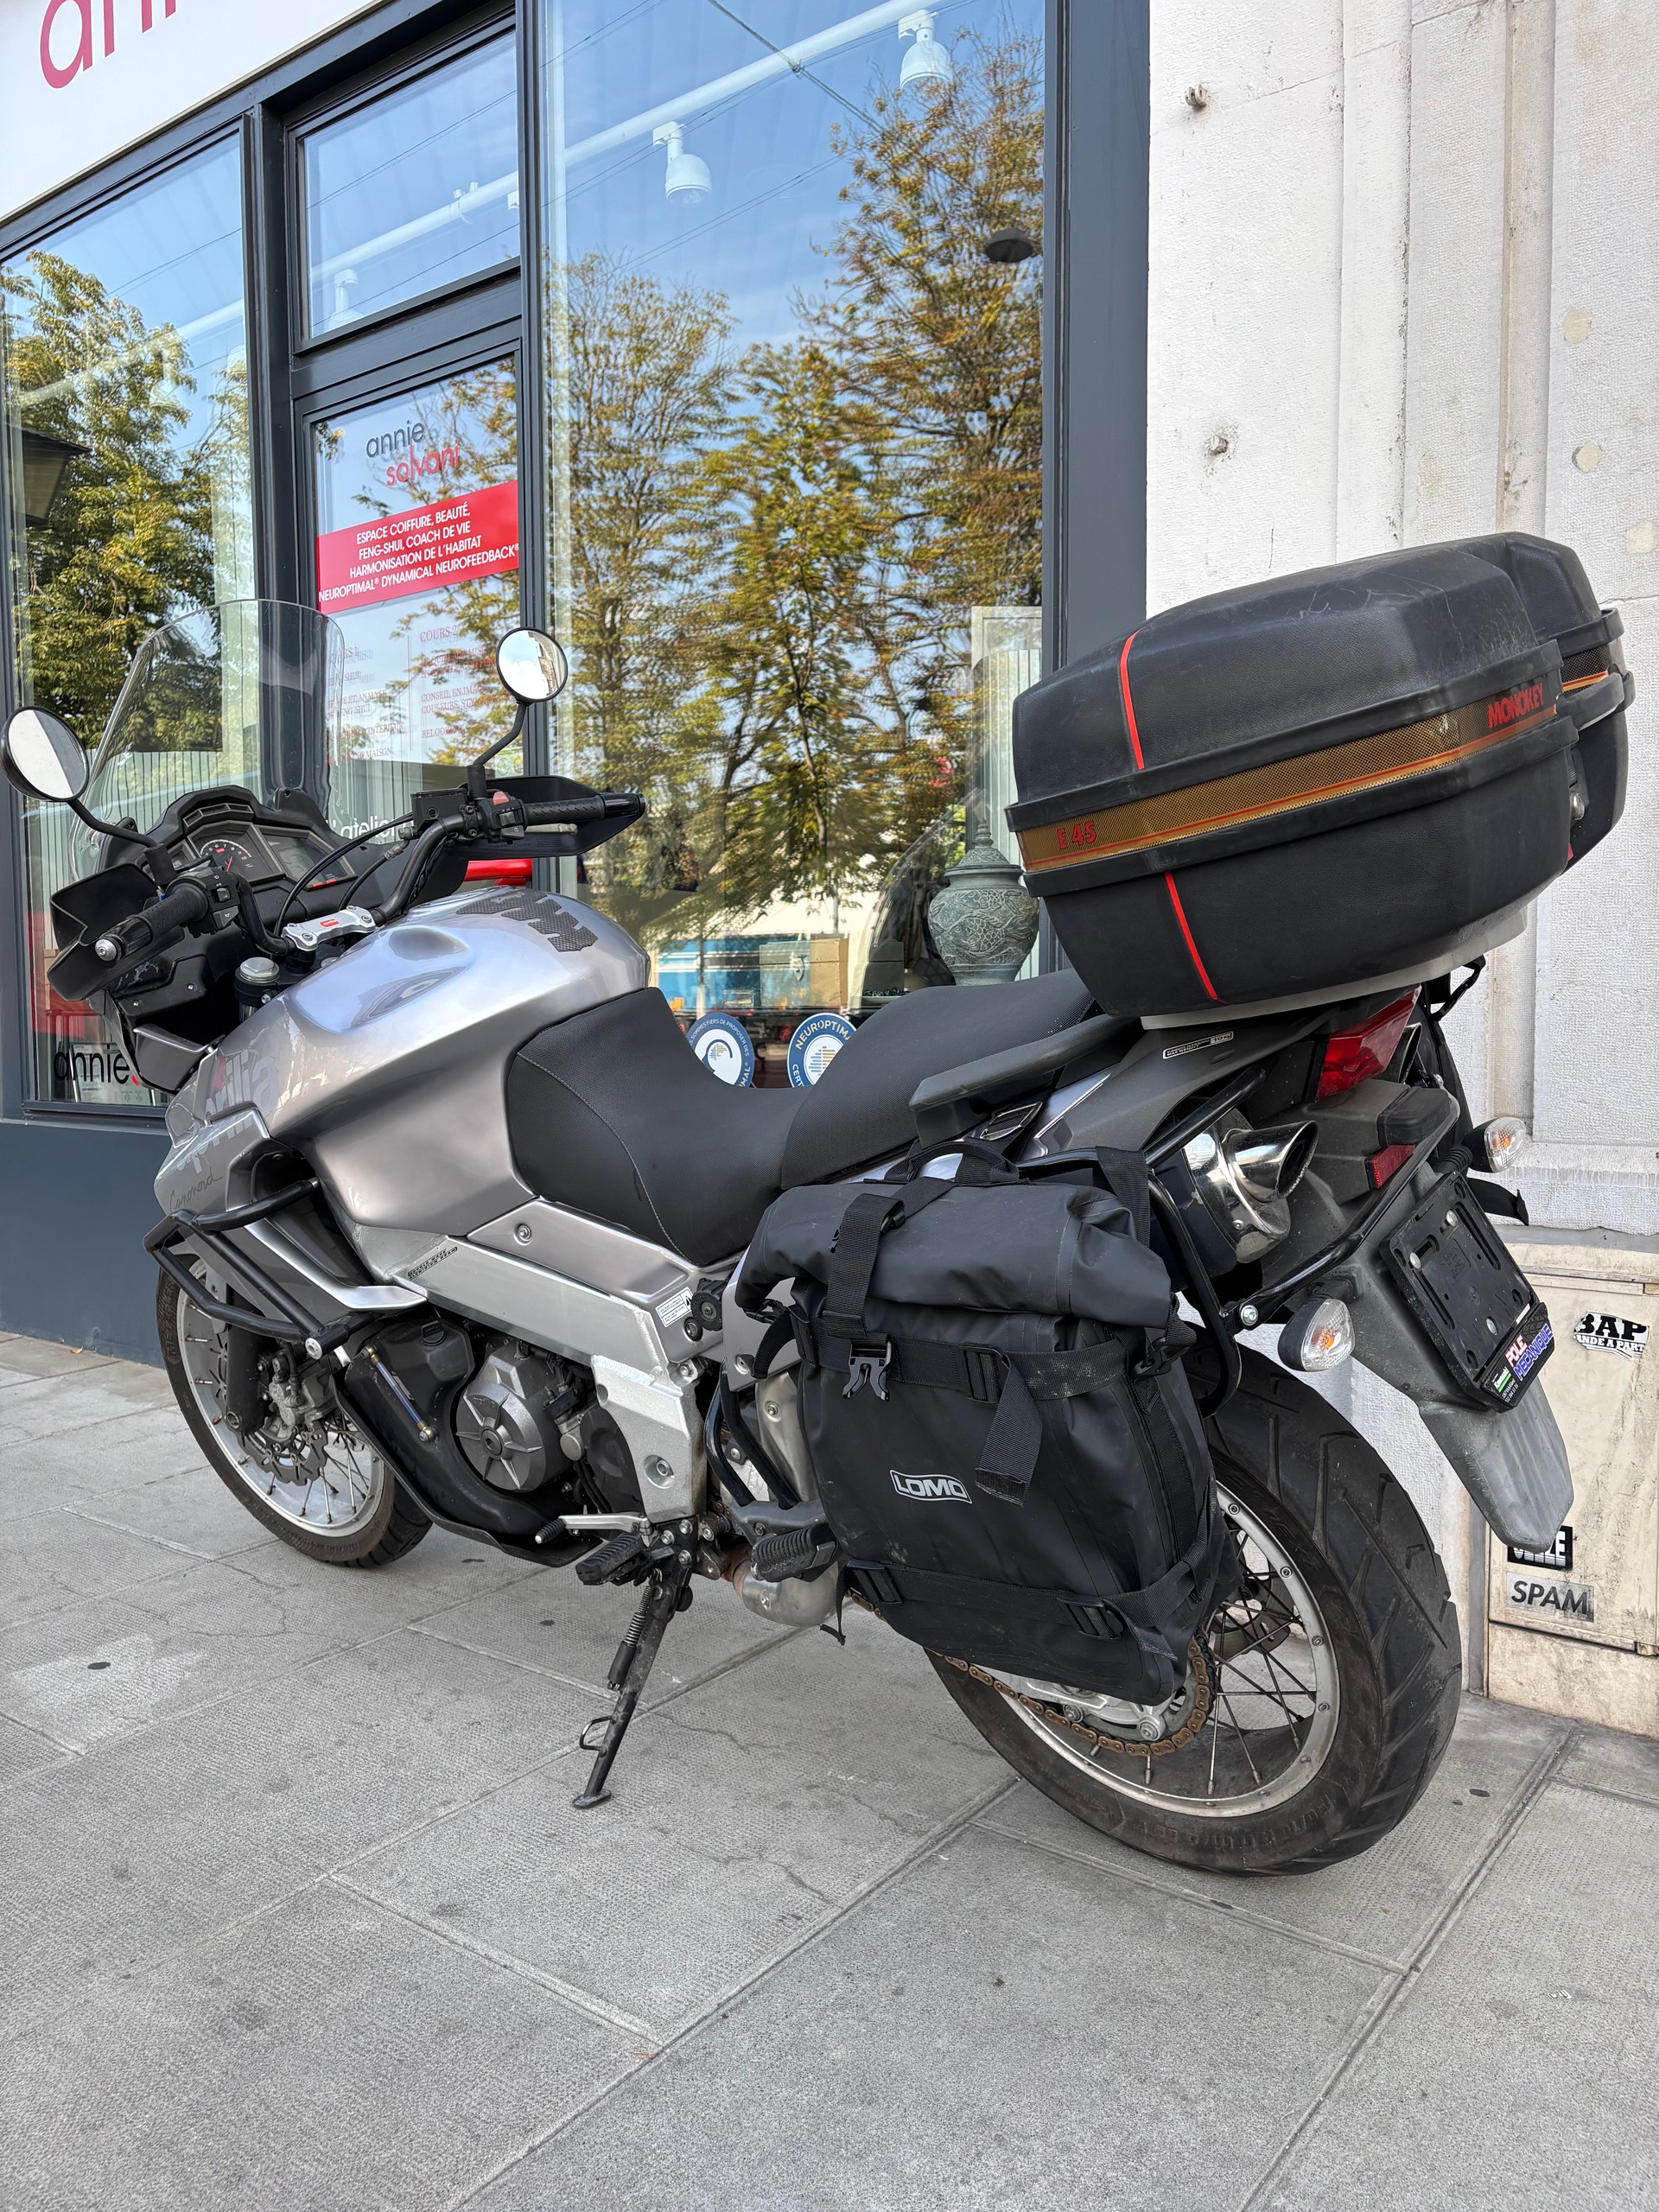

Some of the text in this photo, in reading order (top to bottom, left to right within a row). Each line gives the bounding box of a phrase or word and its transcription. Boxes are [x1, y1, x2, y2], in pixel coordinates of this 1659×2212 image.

[366, 419, 425, 458] annie
[386, 438, 460, 486] solvani
[357, 501, 471, 544] ESPACE COIFFURE, BEAUTÉ,
[350, 535, 482, 578] HARMONISATION DE L'HABITAT
[359, 521, 471, 560] FENG-SHUI, COACH DE VIE
[381, 564, 434, 588] DYNAMICAL
[420, 625, 458, 643] COURS 2
[421, 690, 449, 702] CONSEIL
[1487, 682, 1544, 729] MONOKEY
[1057, 821, 1096, 850] E 45
[1504, 1333, 1528, 1368] POLE
[1513, 1322, 1554, 1382] MECANIQUE
[1606, 1338, 1615, 1348] A
[1616, 1340, 1645, 1352] PART
[893, 1474, 968, 1499] LOMO
[1511, 1580, 1587, 1615] SPAM
